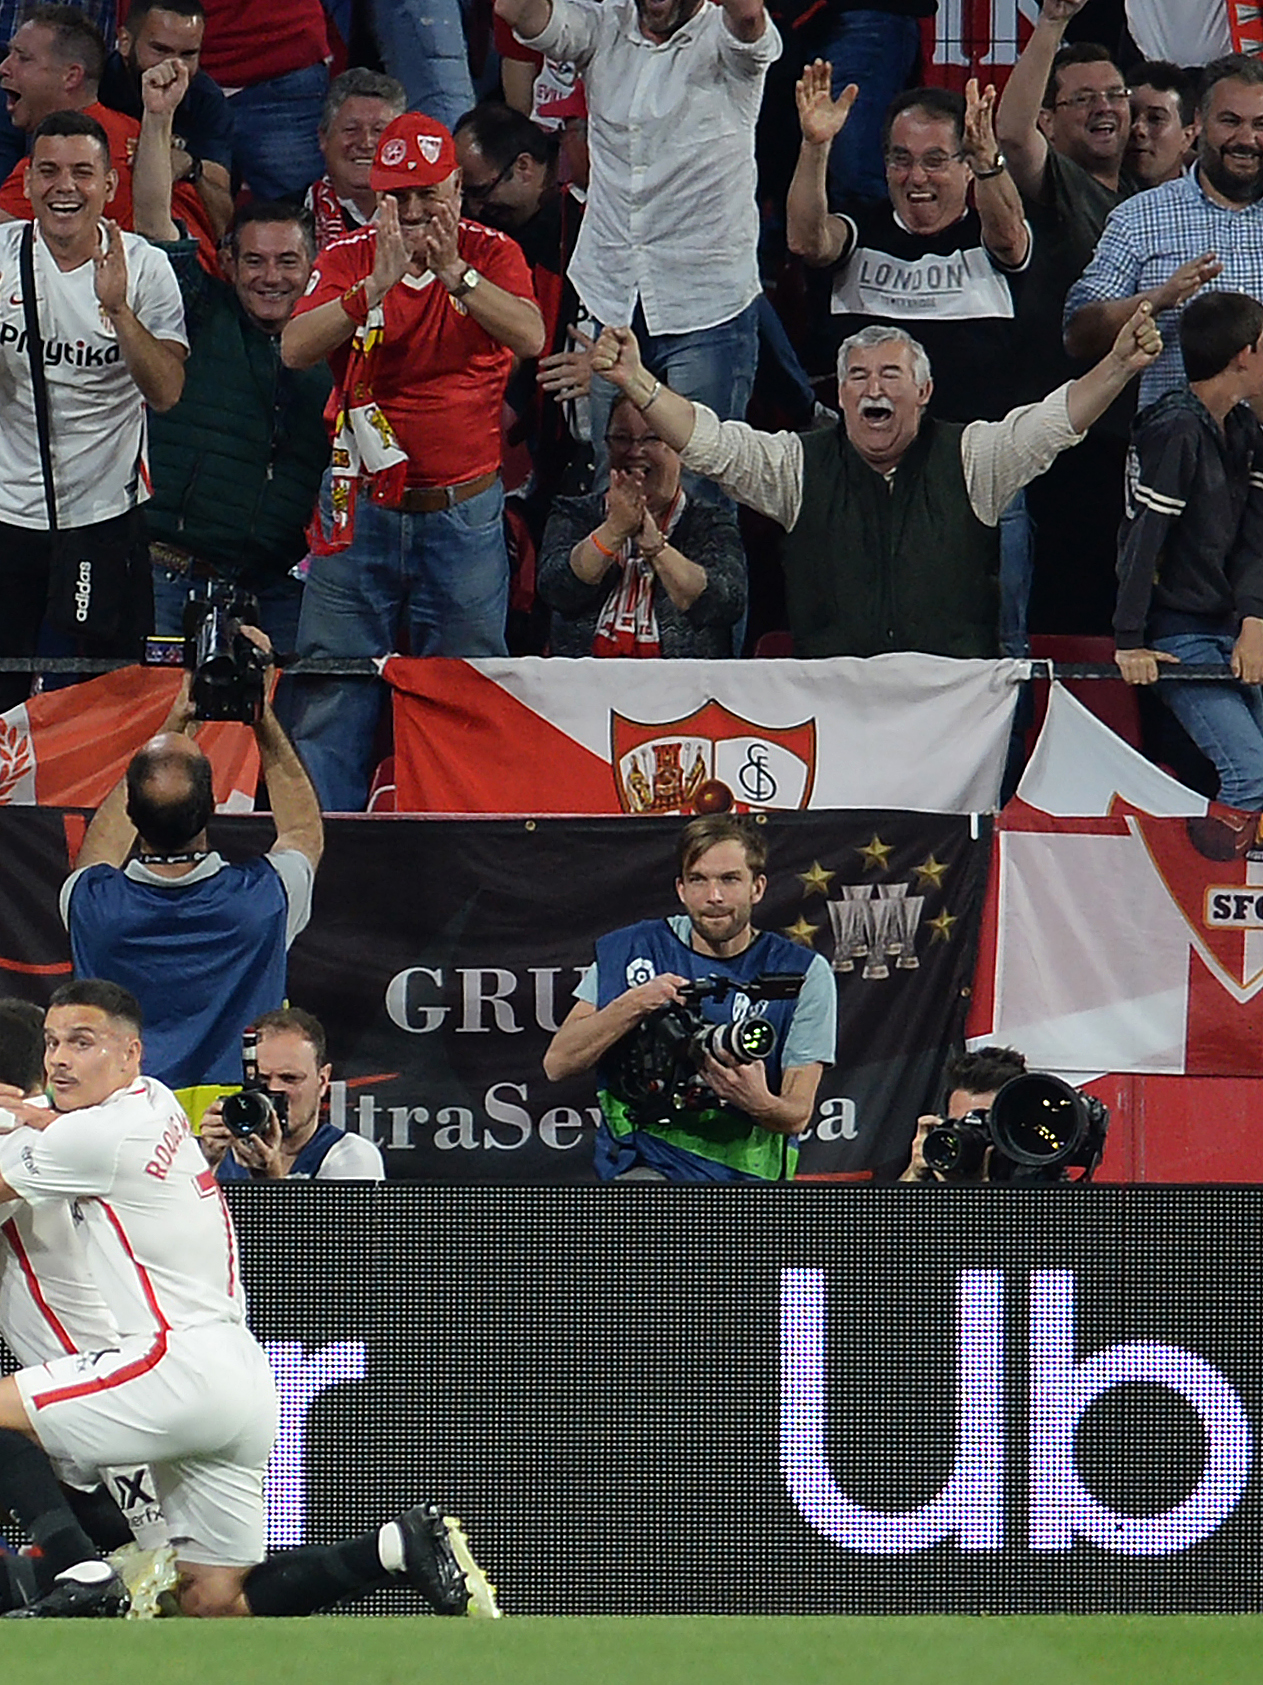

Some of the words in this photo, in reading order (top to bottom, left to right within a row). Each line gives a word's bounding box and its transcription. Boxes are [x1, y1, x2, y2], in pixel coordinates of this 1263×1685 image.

[860, 260, 963, 290] LONDON
[0, 321, 120, 367] Plytika
[75, 561, 92, 622] adidas
[386, 966, 594, 1033] GRU
[780, 1267, 1252, 1555] Ub
